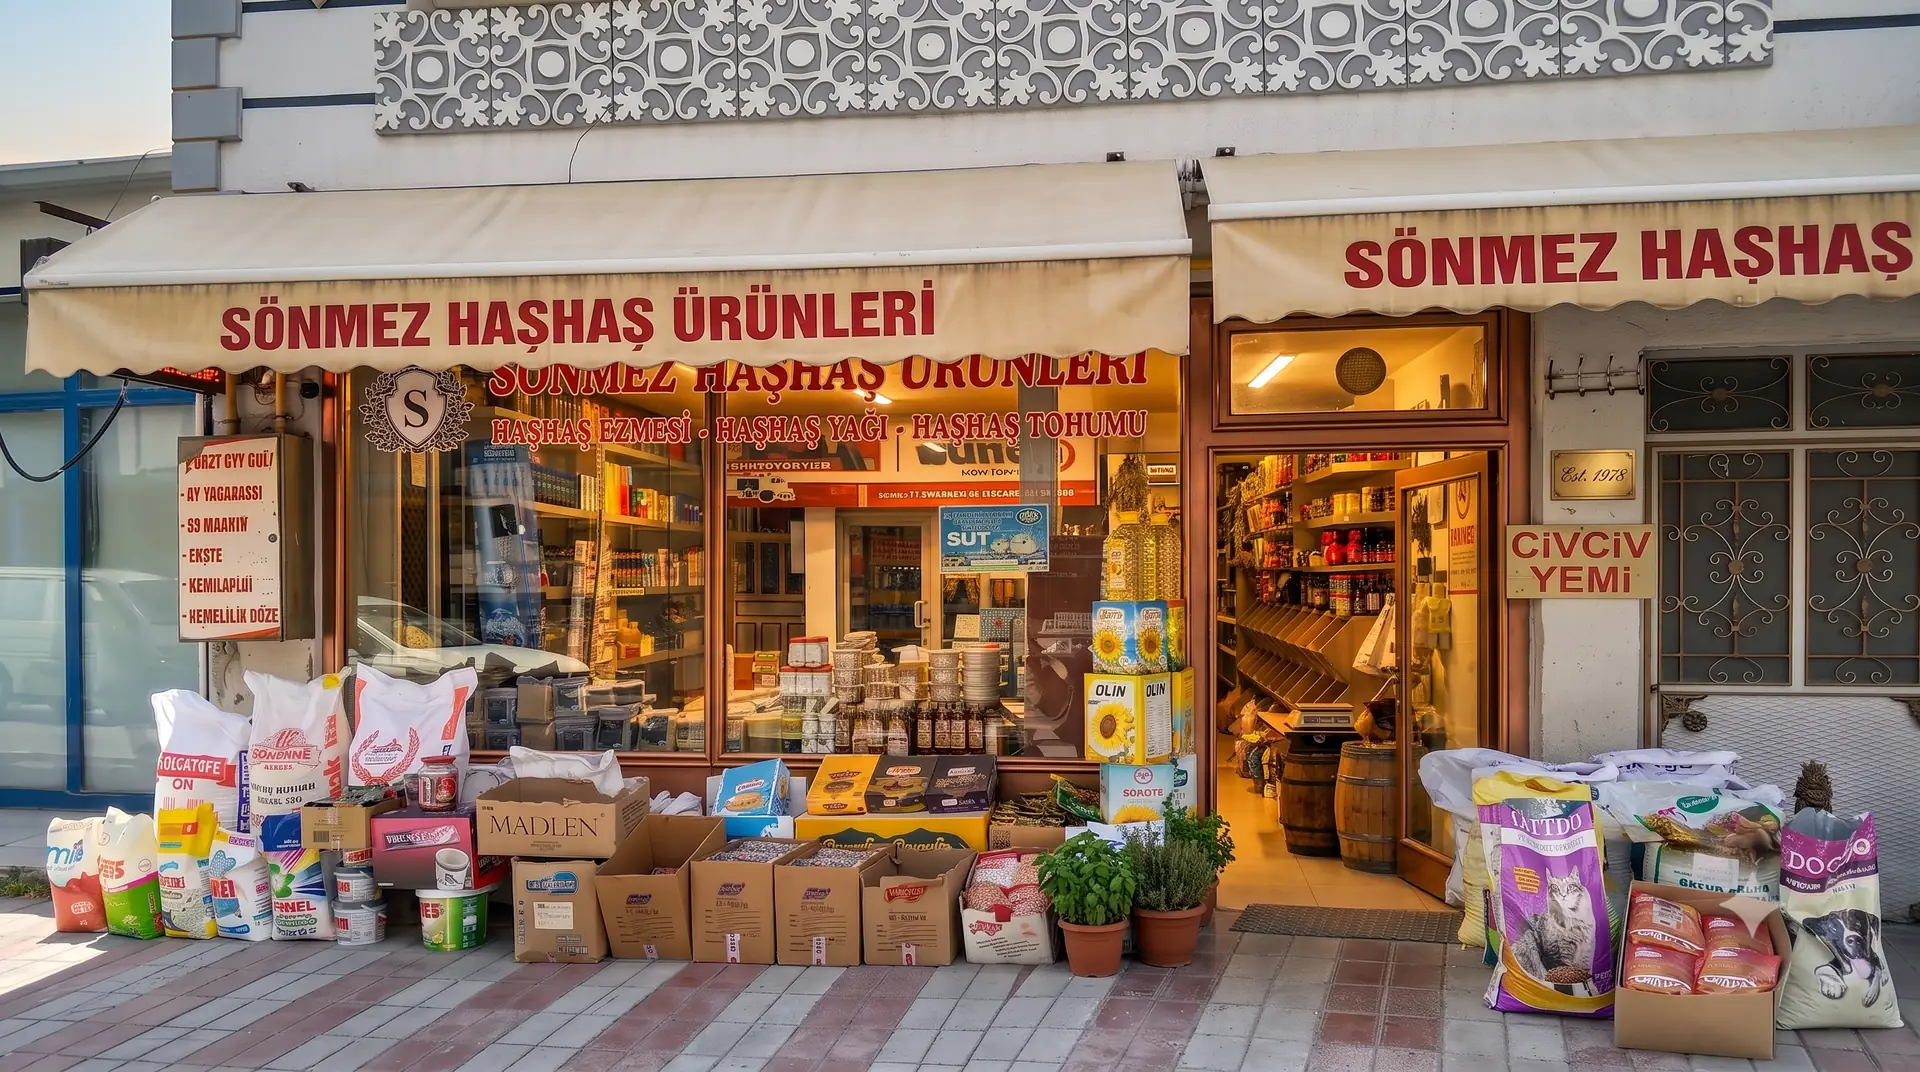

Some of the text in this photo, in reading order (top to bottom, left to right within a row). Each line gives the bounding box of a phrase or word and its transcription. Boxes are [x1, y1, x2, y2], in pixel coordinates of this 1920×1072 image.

[1344, 221, 1913, 289] SÖNMEZ HAŞHAŞ
[220, 280, 935, 354] SÖNMEZ HAŞHAŞ ÜRÜNLERİ
[403, 389, 430, 428] S
[491, 409, 1149, 451] HAŞHAŞ EZMESİ HAŞHAŞ YAĞI HAŞHAŞ TOHUMU
[1561, 466, 1628, 483] Est. 1978
[187, 486, 201, 502] AY
[946, 531, 992, 547] SUT
[489, 814, 598, 837] MADLEN
